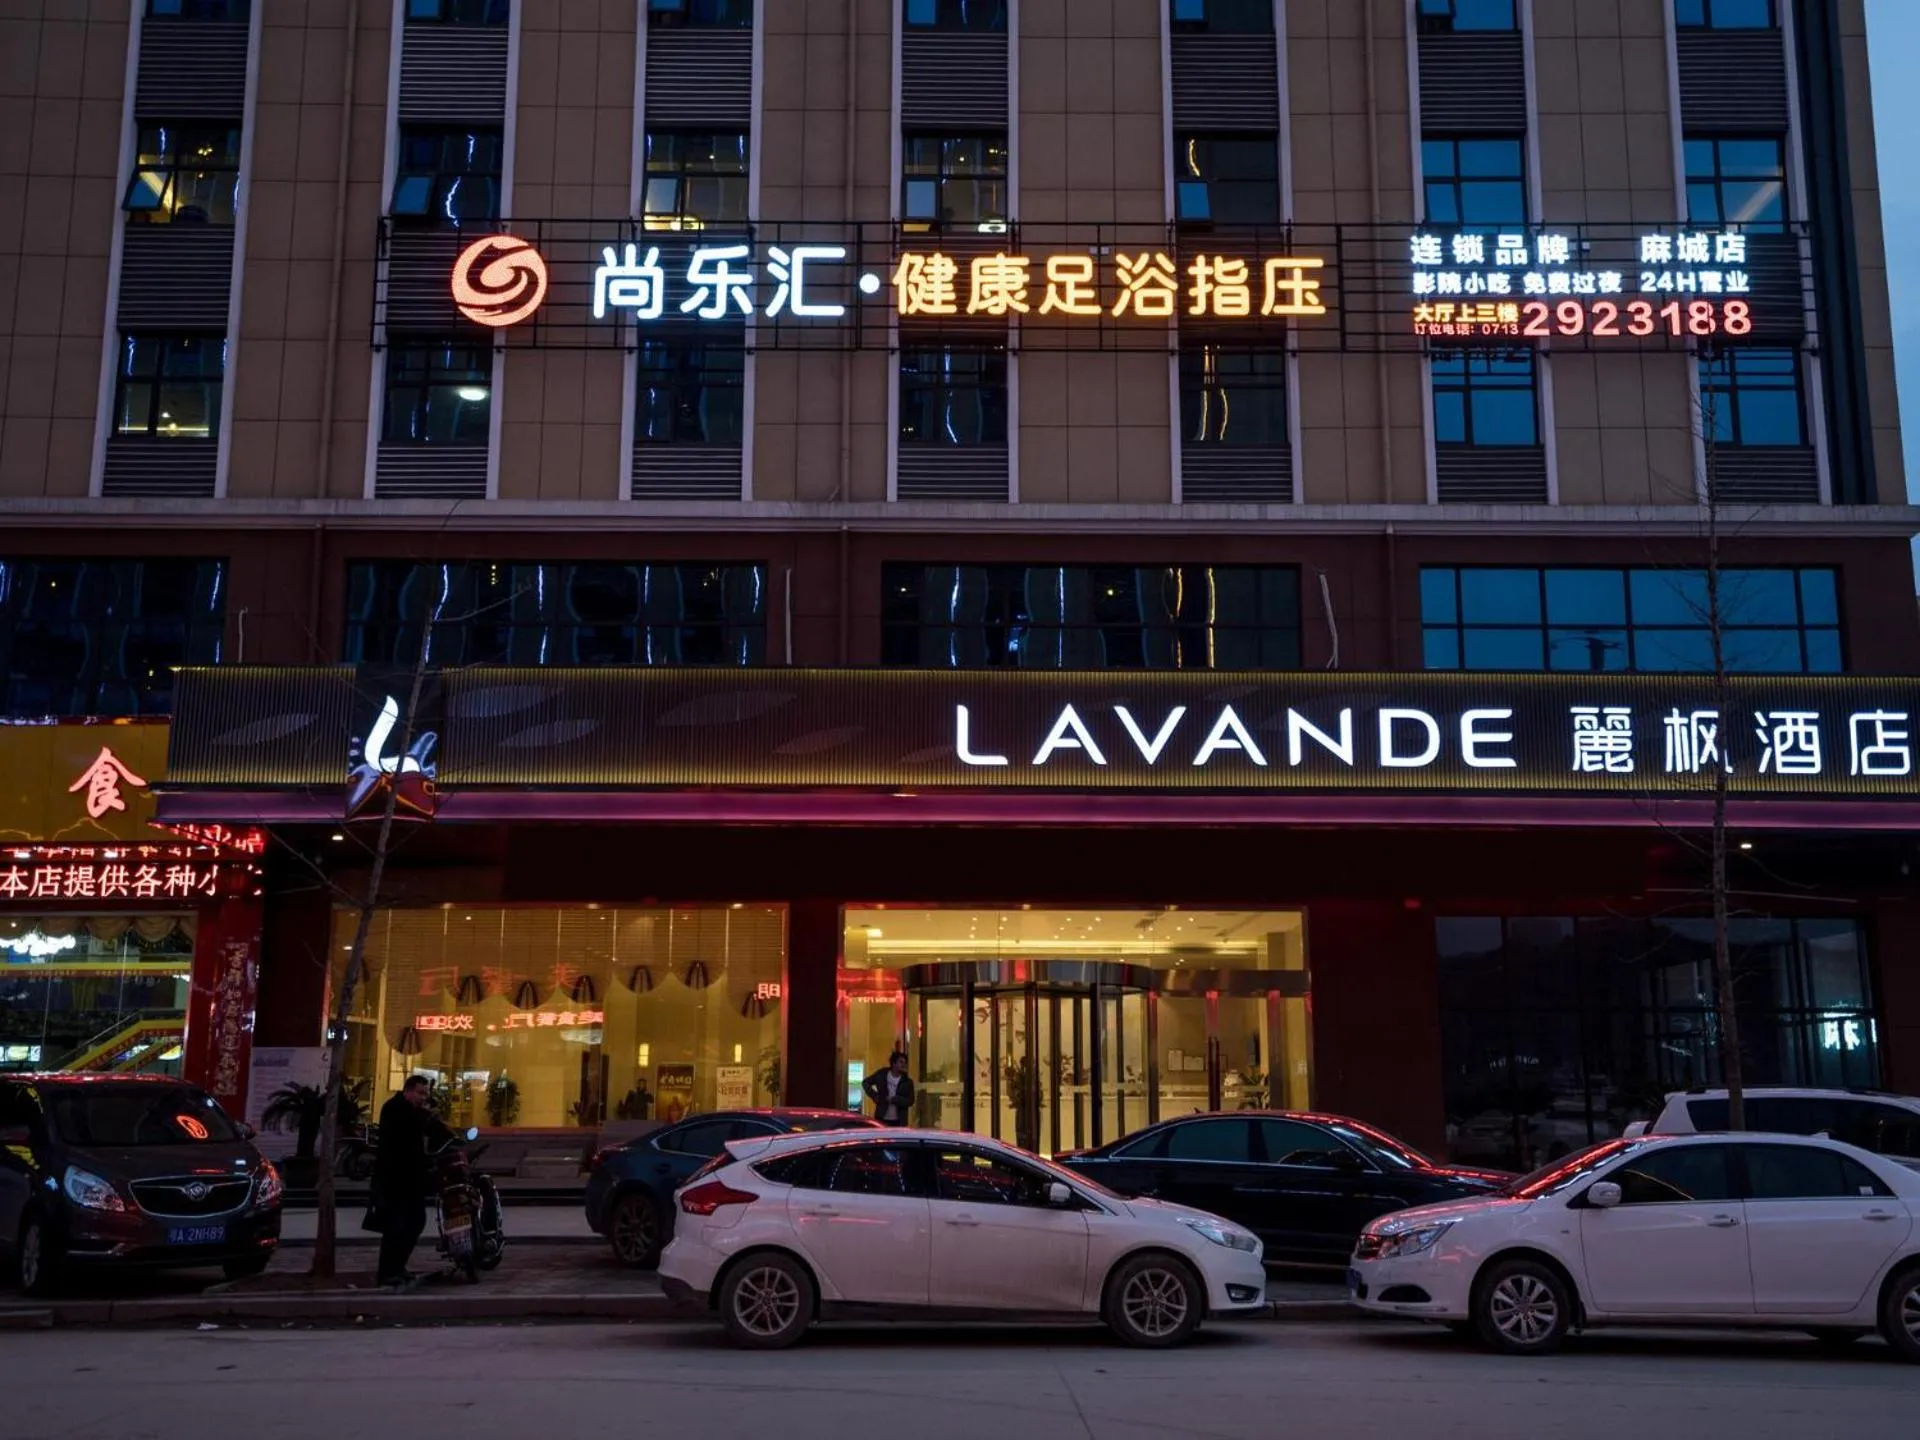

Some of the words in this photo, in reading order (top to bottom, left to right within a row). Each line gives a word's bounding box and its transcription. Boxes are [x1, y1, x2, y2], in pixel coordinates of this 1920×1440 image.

[1411, 234, 1570, 265] 连锁品牌
[1641, 232, 1746, 263] 麻城店
[1413, 272, 1511, 294] 影院小吃
[1523, 271, 1622, 294] 免费过夜
[1641, 271, 1750, 293] 24H营业
[1413, 302, 1519, 323] 大厅上三楼
[1523, 301, 1752, 336] 2923188
[957, 703, 1517, 768] LAVANDE
[1570, 706, 1912, 776] 麗枫酒店
[68, 746, 147, 818] 食
